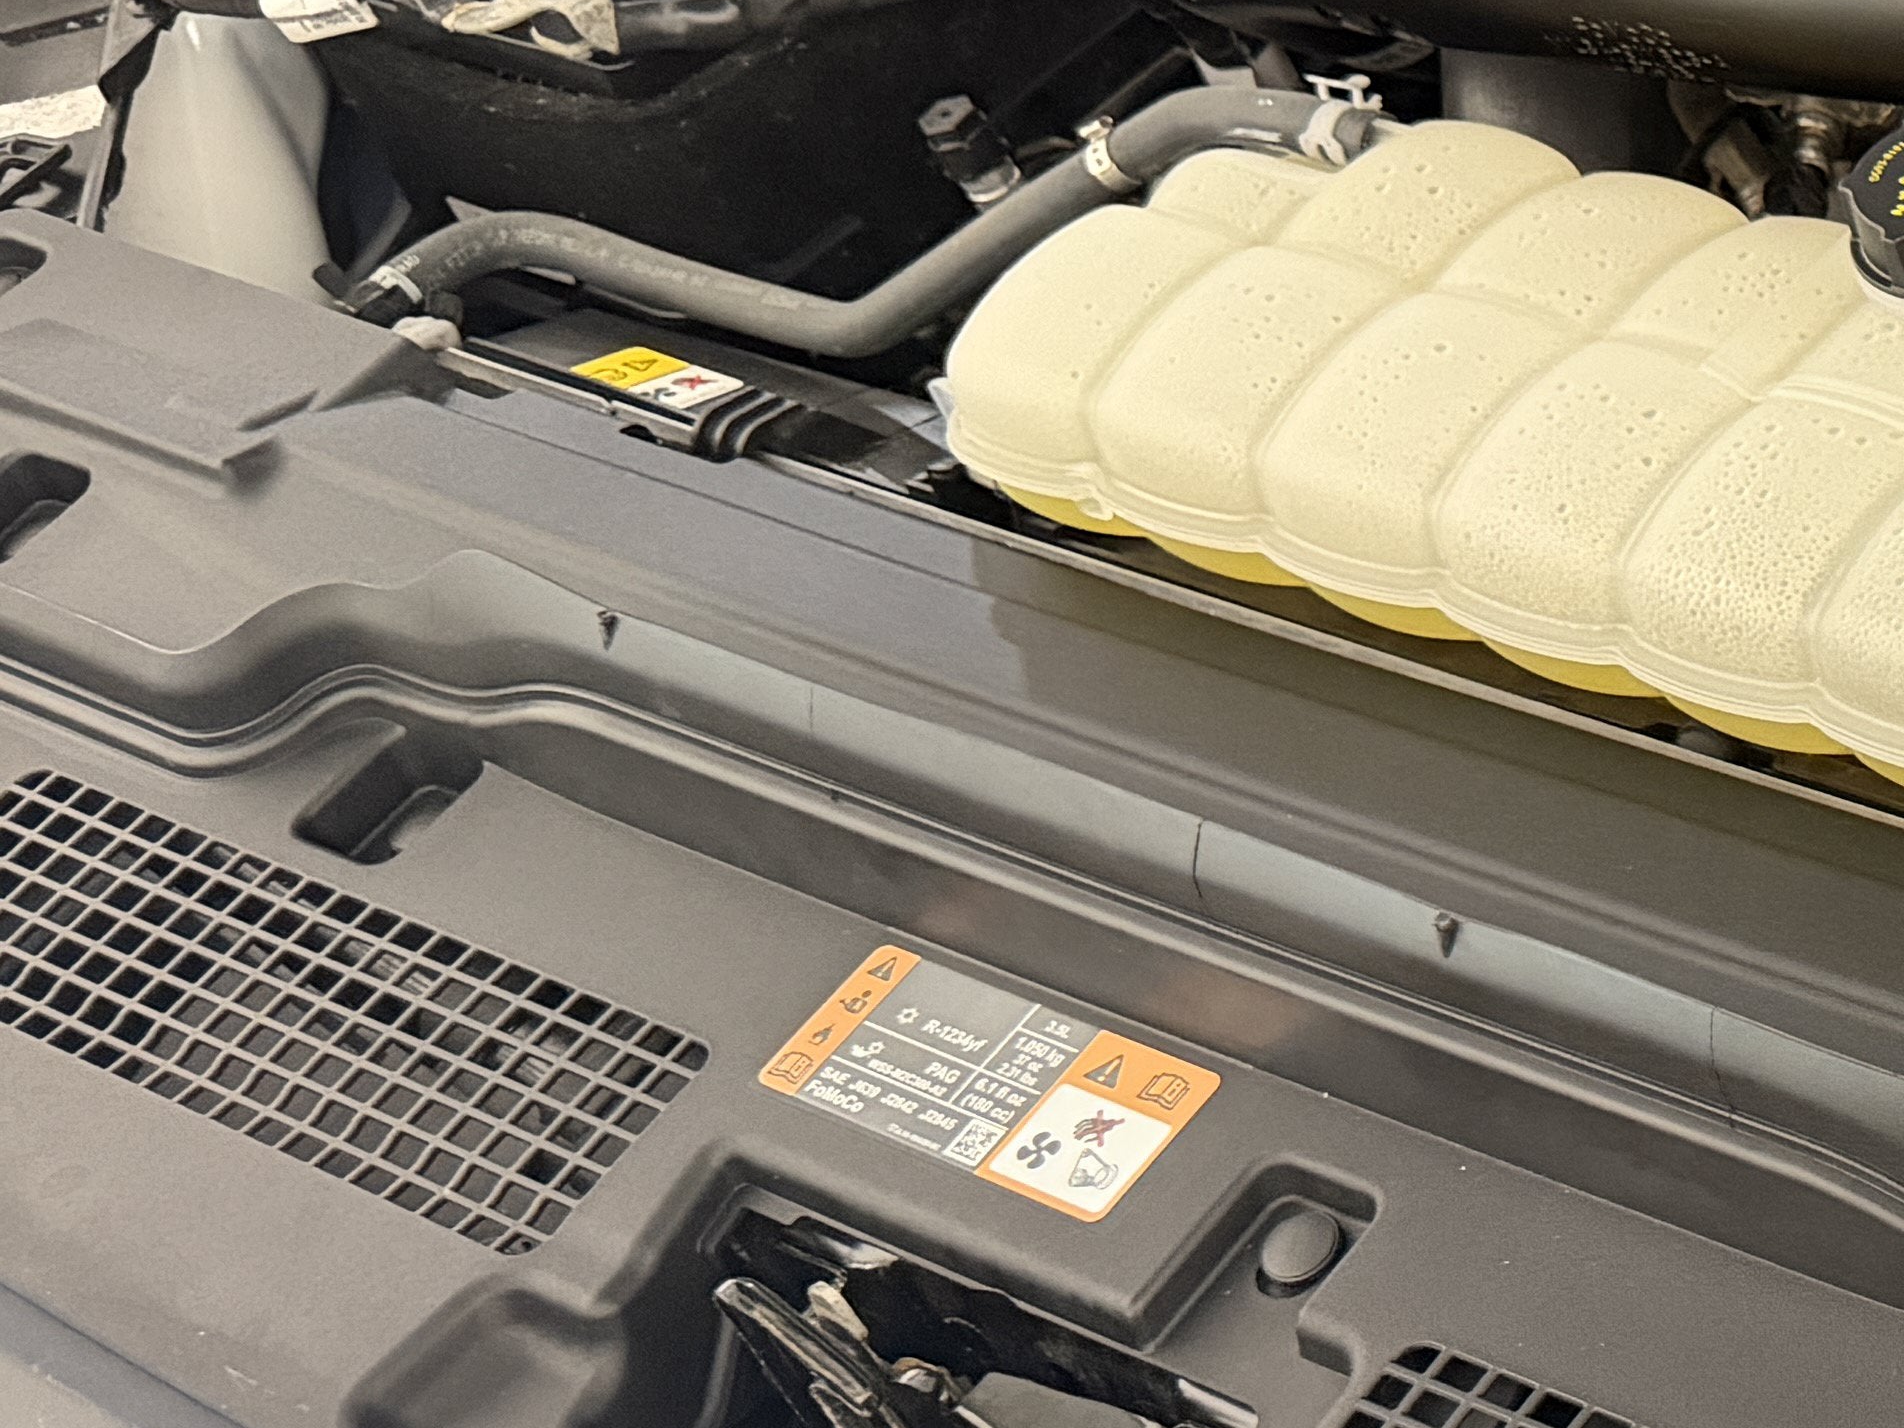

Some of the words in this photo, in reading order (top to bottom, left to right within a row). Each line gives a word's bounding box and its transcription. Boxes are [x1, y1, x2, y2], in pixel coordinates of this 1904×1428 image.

[921, 1019, 989, 1052] R-1234yf
[1014, 1036, 1051, 1058] 1.050
[1044, 1048, 1066, 1068] kg
[1026, 1061, 1044, 1073] oz
[820, 1066, 851, 1085] SAE
[848, 1080, 882, 1099] J639
[923, 1061, 961, 1084] PAG
[1019, 1072, 1038, 1086] lbs
[804, 1078, 865, 1113] FoMoCo
[959, 1092, 995, 1114] (180
[989, 1107, 1016, 1125] cc)
[974, 1078, 1000, 1095] 6.1
[994, 1085, 1012, 1099] fl
[1005, 1092, 1028, 1107] oz
